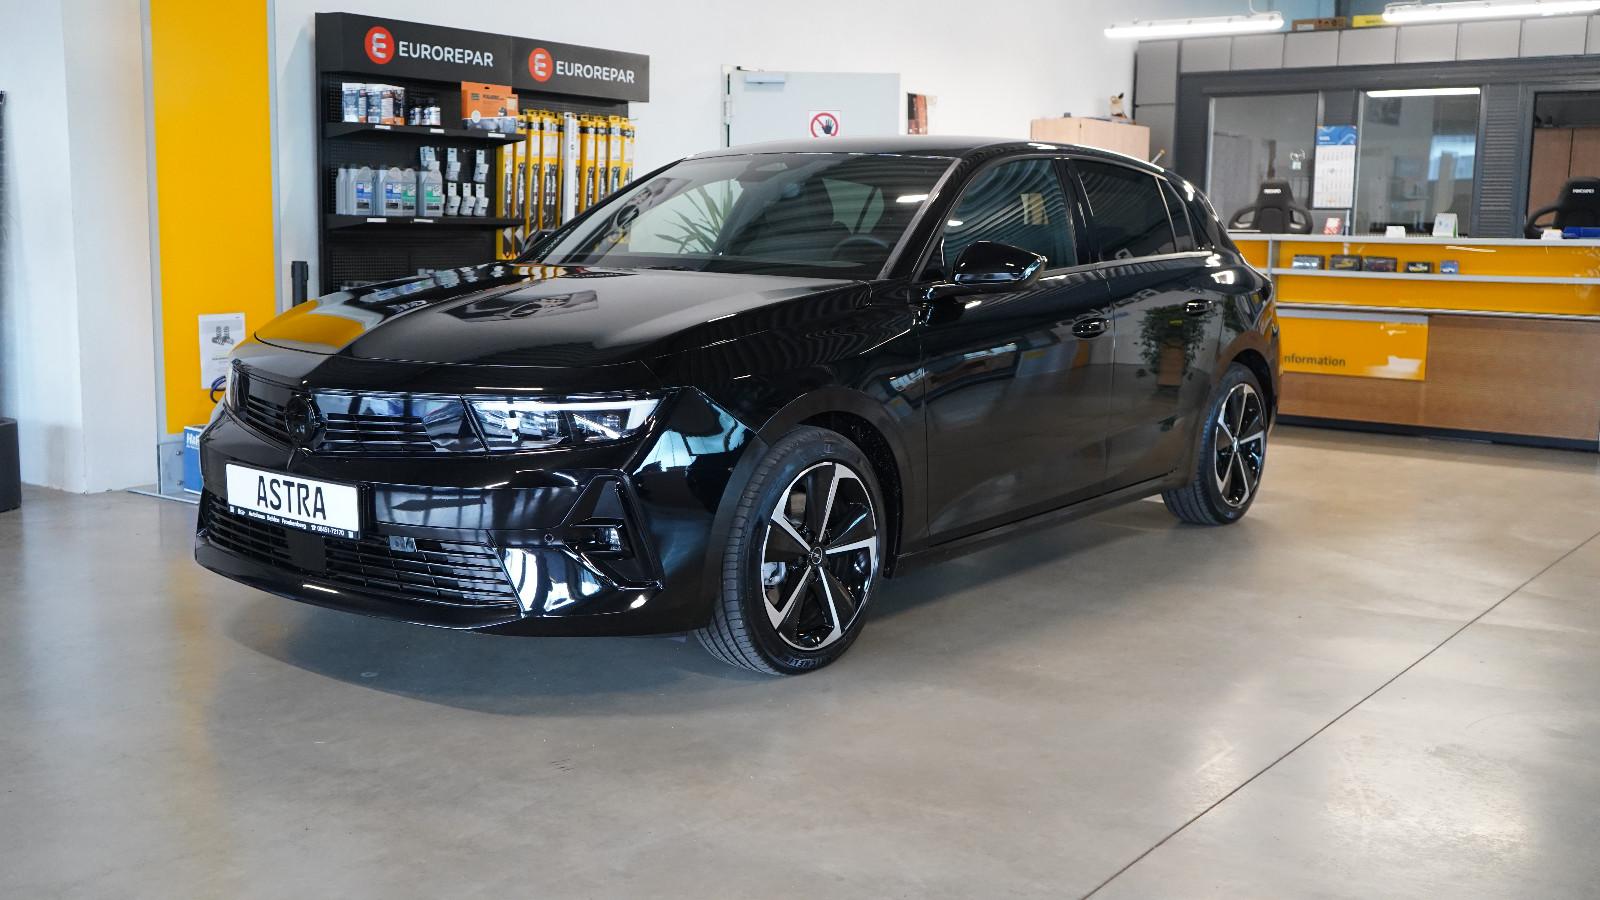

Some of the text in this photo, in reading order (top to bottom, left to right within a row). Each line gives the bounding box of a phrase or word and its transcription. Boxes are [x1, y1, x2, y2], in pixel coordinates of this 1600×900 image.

[398, 40, 494, 67] EUROREPAR
[556, 60, 635, 84] EUROREPAR
[1283, 353, 1346, 367] nformation
[257, 475, 327, 520] ASTRA
